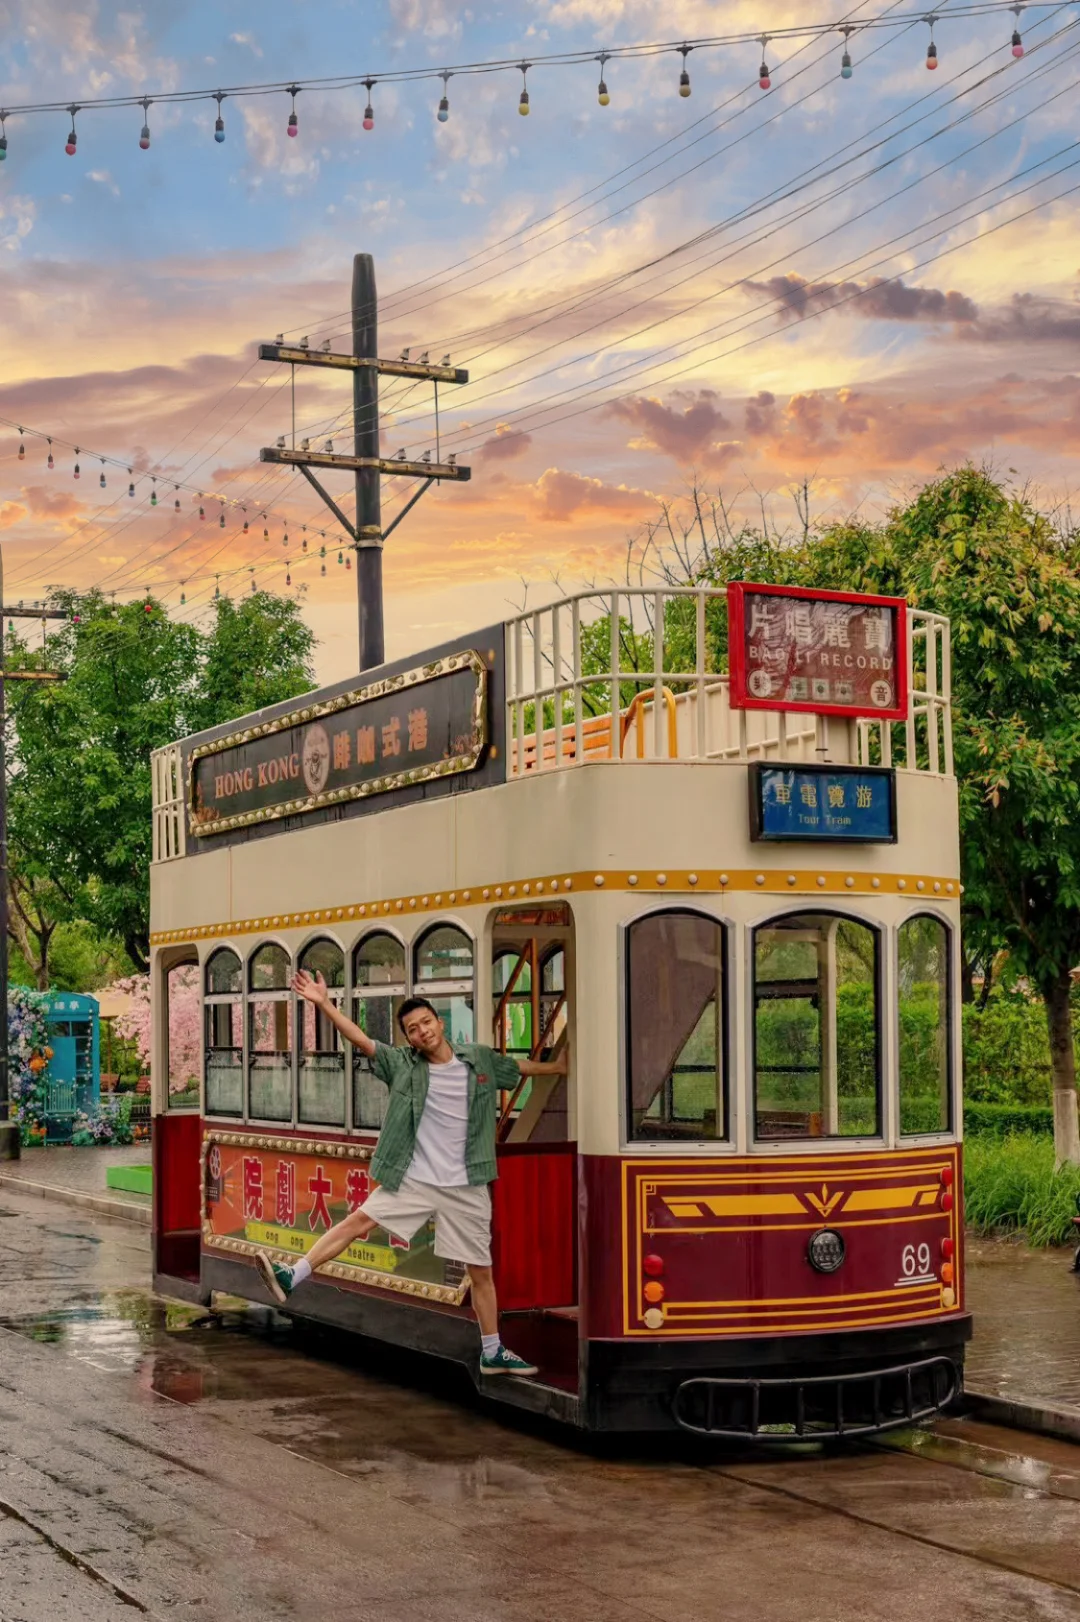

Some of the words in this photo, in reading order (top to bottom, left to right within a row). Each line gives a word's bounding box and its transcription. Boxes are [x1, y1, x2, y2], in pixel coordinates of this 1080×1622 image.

[749, 645, 786, 660] BAO
[820, 652, 893, 670] RECORD
[214, 767, 254, 799] HONG
[257, 753, 300, 788] KONG
[798, 813, 819, 824] Tour
[826, 815, 852, 825] Tram
[902, 1242, 930, 1276] 69
